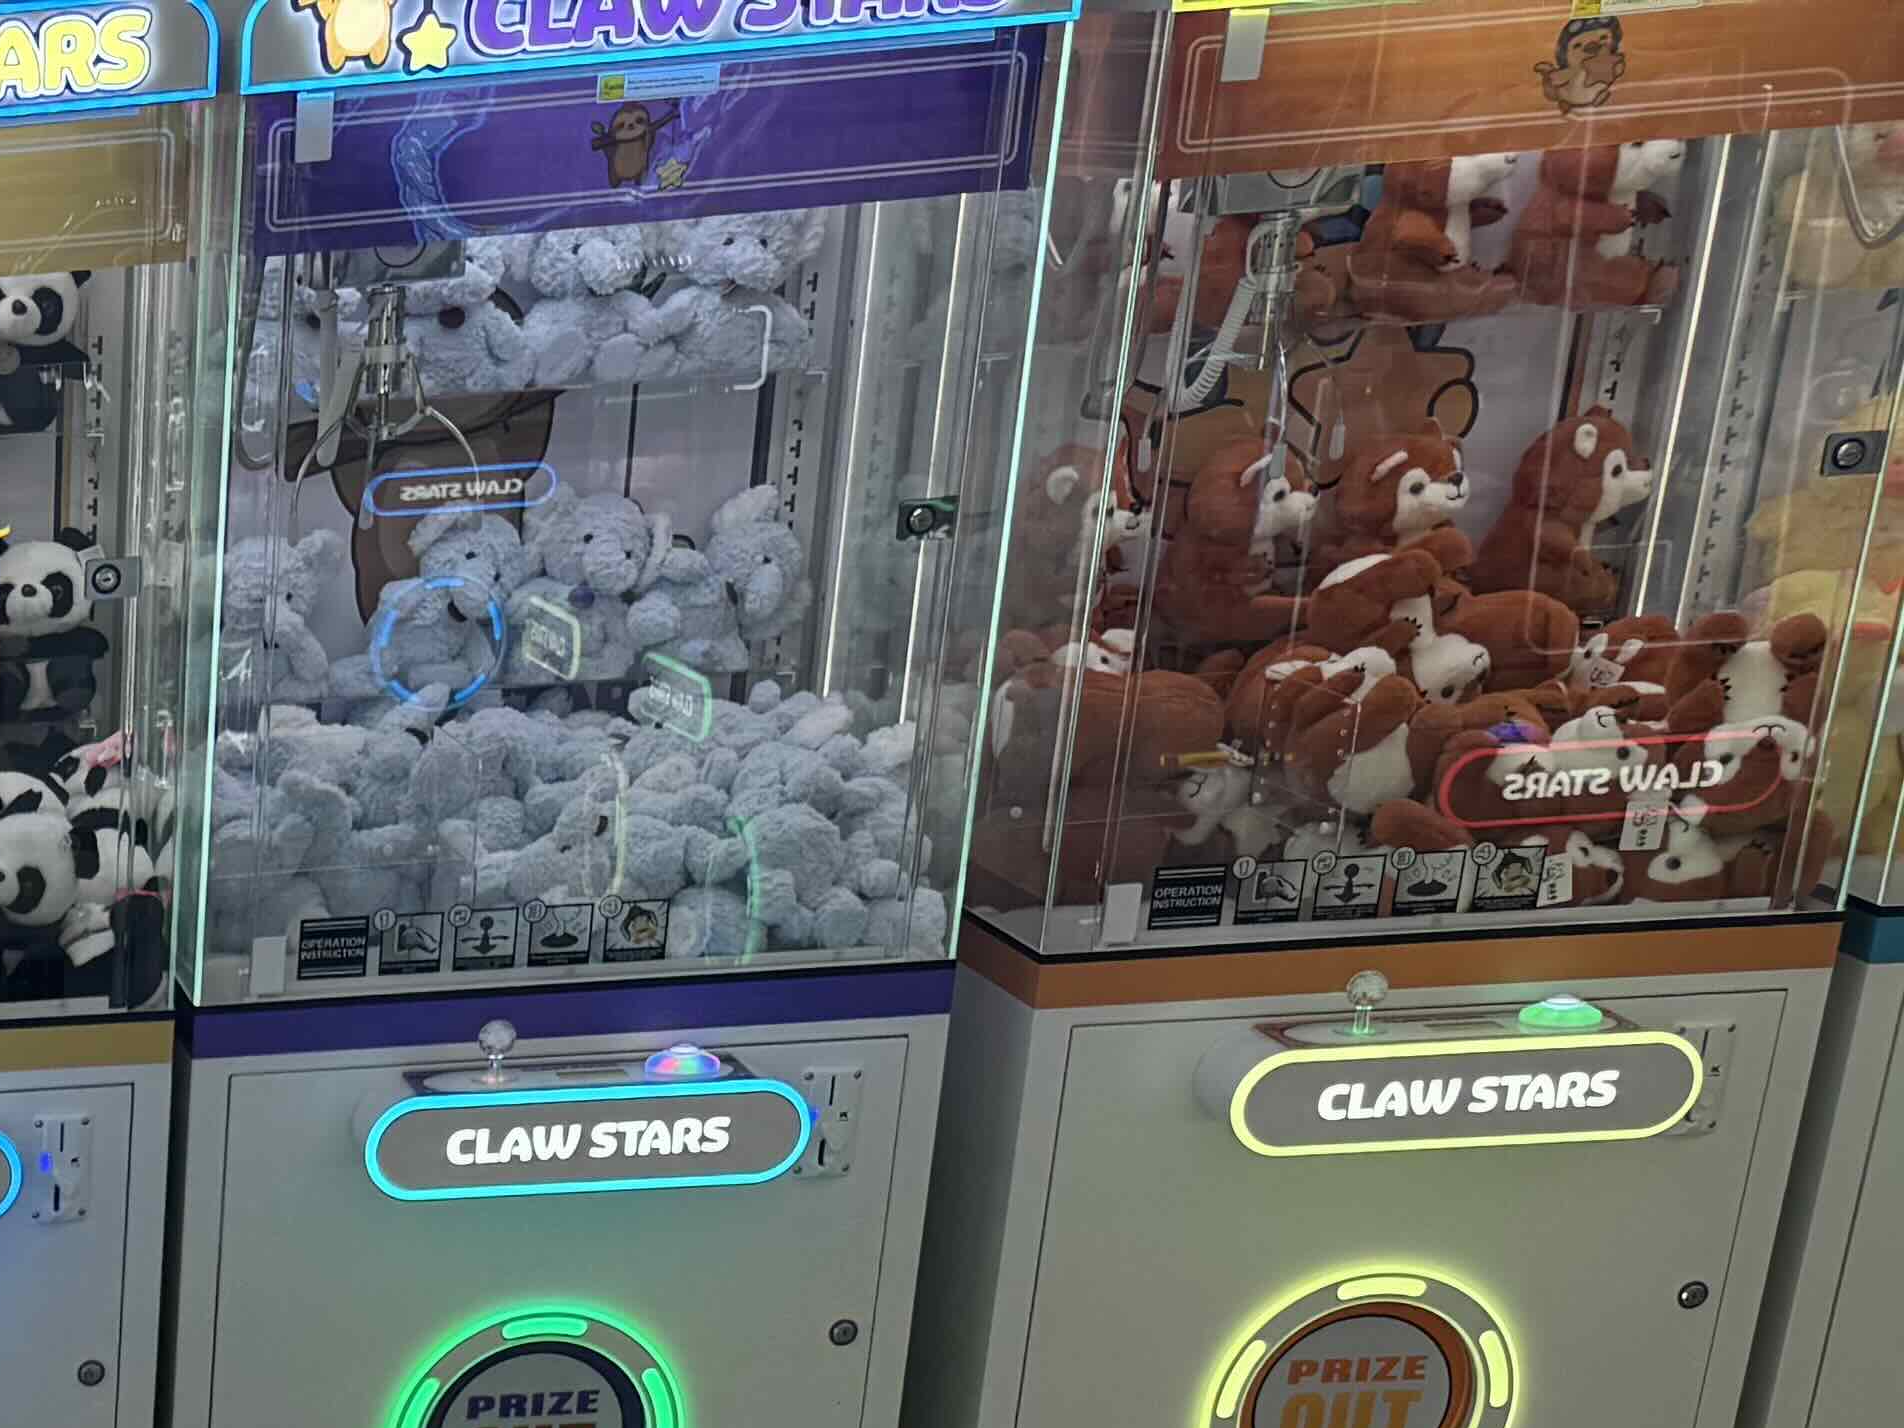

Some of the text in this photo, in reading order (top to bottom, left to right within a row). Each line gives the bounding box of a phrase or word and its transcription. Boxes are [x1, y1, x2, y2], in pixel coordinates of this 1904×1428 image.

[1153, 895, 1220, 910] INSTRUCTION
[1154, 884, 1223, 898] OPERATION
[1317, 1069, 1619, 1120] CLAW STARS
[446, 1116, 730, 1166] CLAW STARS
[1286, 1354, 1427, 1384] PRIZE
[466, 1390, 600, 1420] PRIZE
